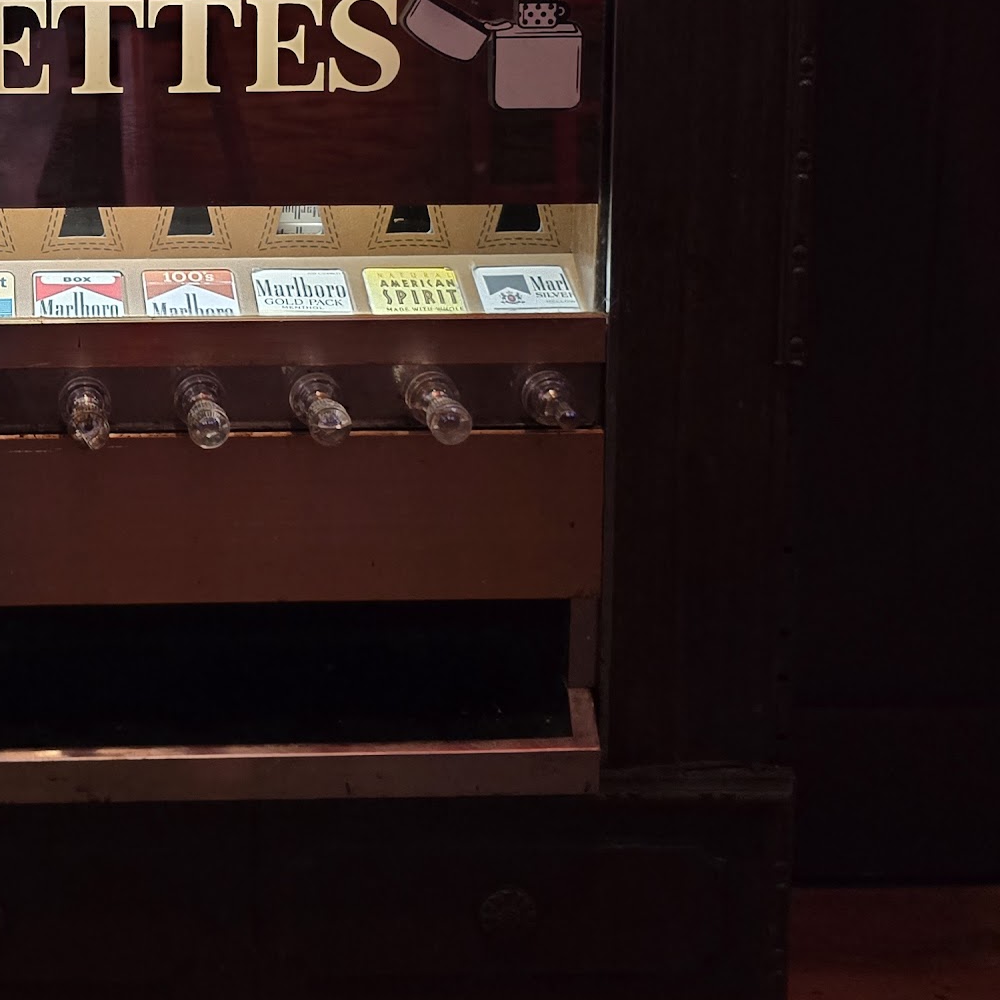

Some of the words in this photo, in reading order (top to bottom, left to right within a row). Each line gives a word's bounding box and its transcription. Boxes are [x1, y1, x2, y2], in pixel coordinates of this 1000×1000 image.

[163, 271, 215, 283] 100's
[380, 279, 456, 288] AMERICAN
[255, 276, 347, 299] Marlboro
[38, 291, 119, 317] Marlboro
[264, 298, 304, 306] GOLD
[309, 298, 345, 307] PACK
[382, 289, 458, 305] SPIRIT
